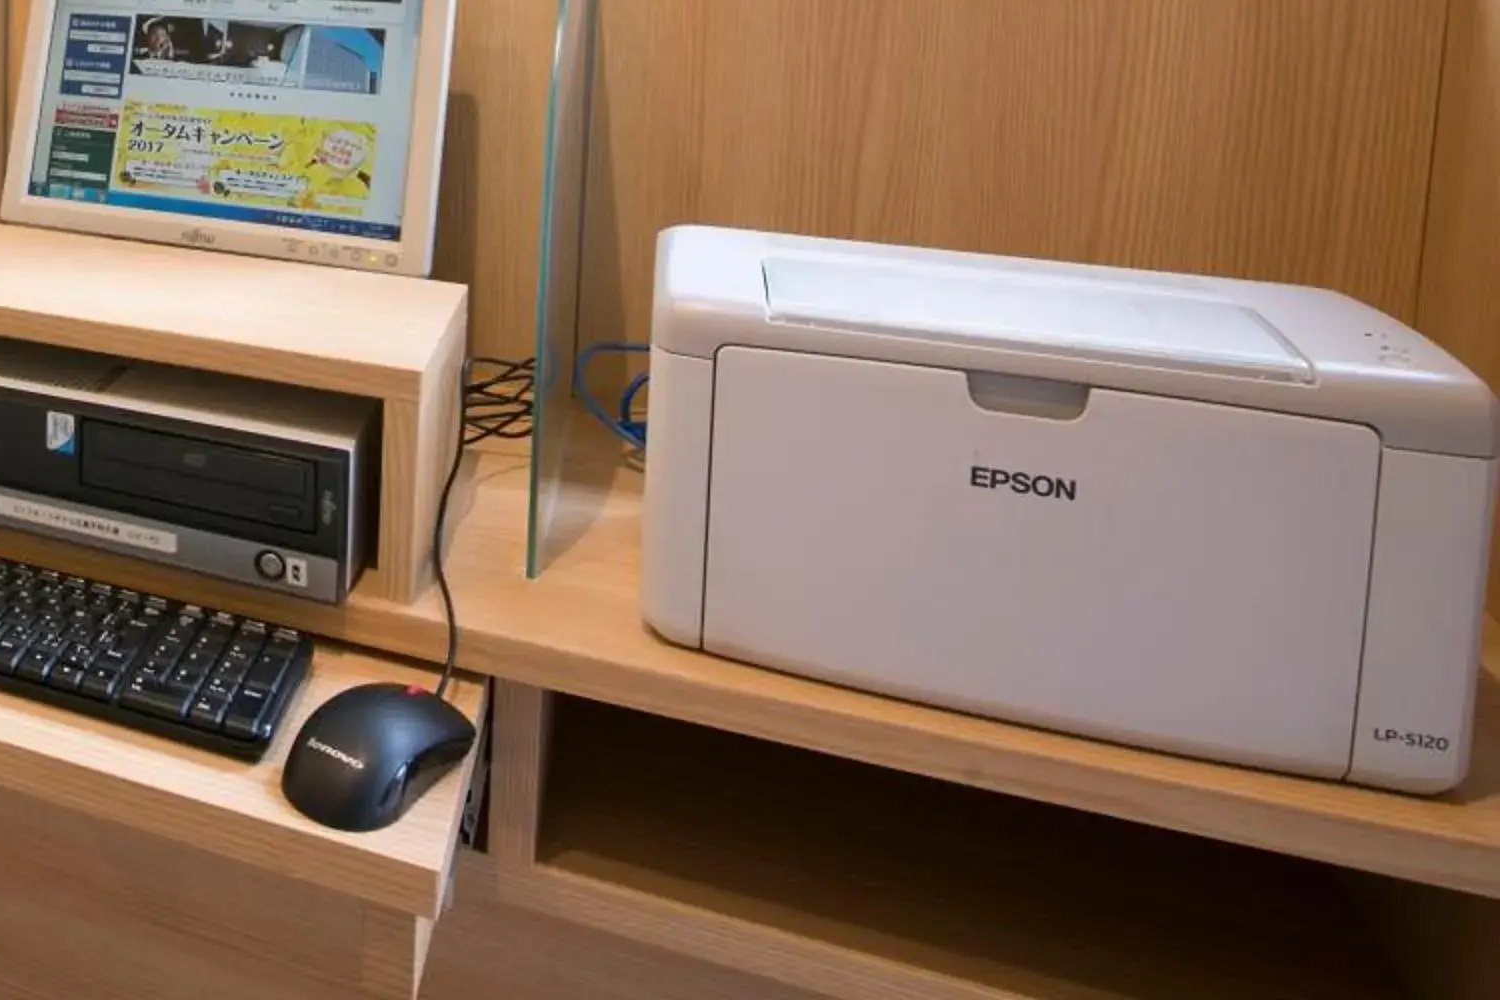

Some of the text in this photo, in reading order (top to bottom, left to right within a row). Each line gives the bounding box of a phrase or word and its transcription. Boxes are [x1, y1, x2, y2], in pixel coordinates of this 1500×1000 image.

[127, 139, 165, 153] 2017
[130, 119, 285, 150] オータムキャンペーン
[969, 465, 1077, 502] EPSON
[306, 736, 365, 770] lenovo
